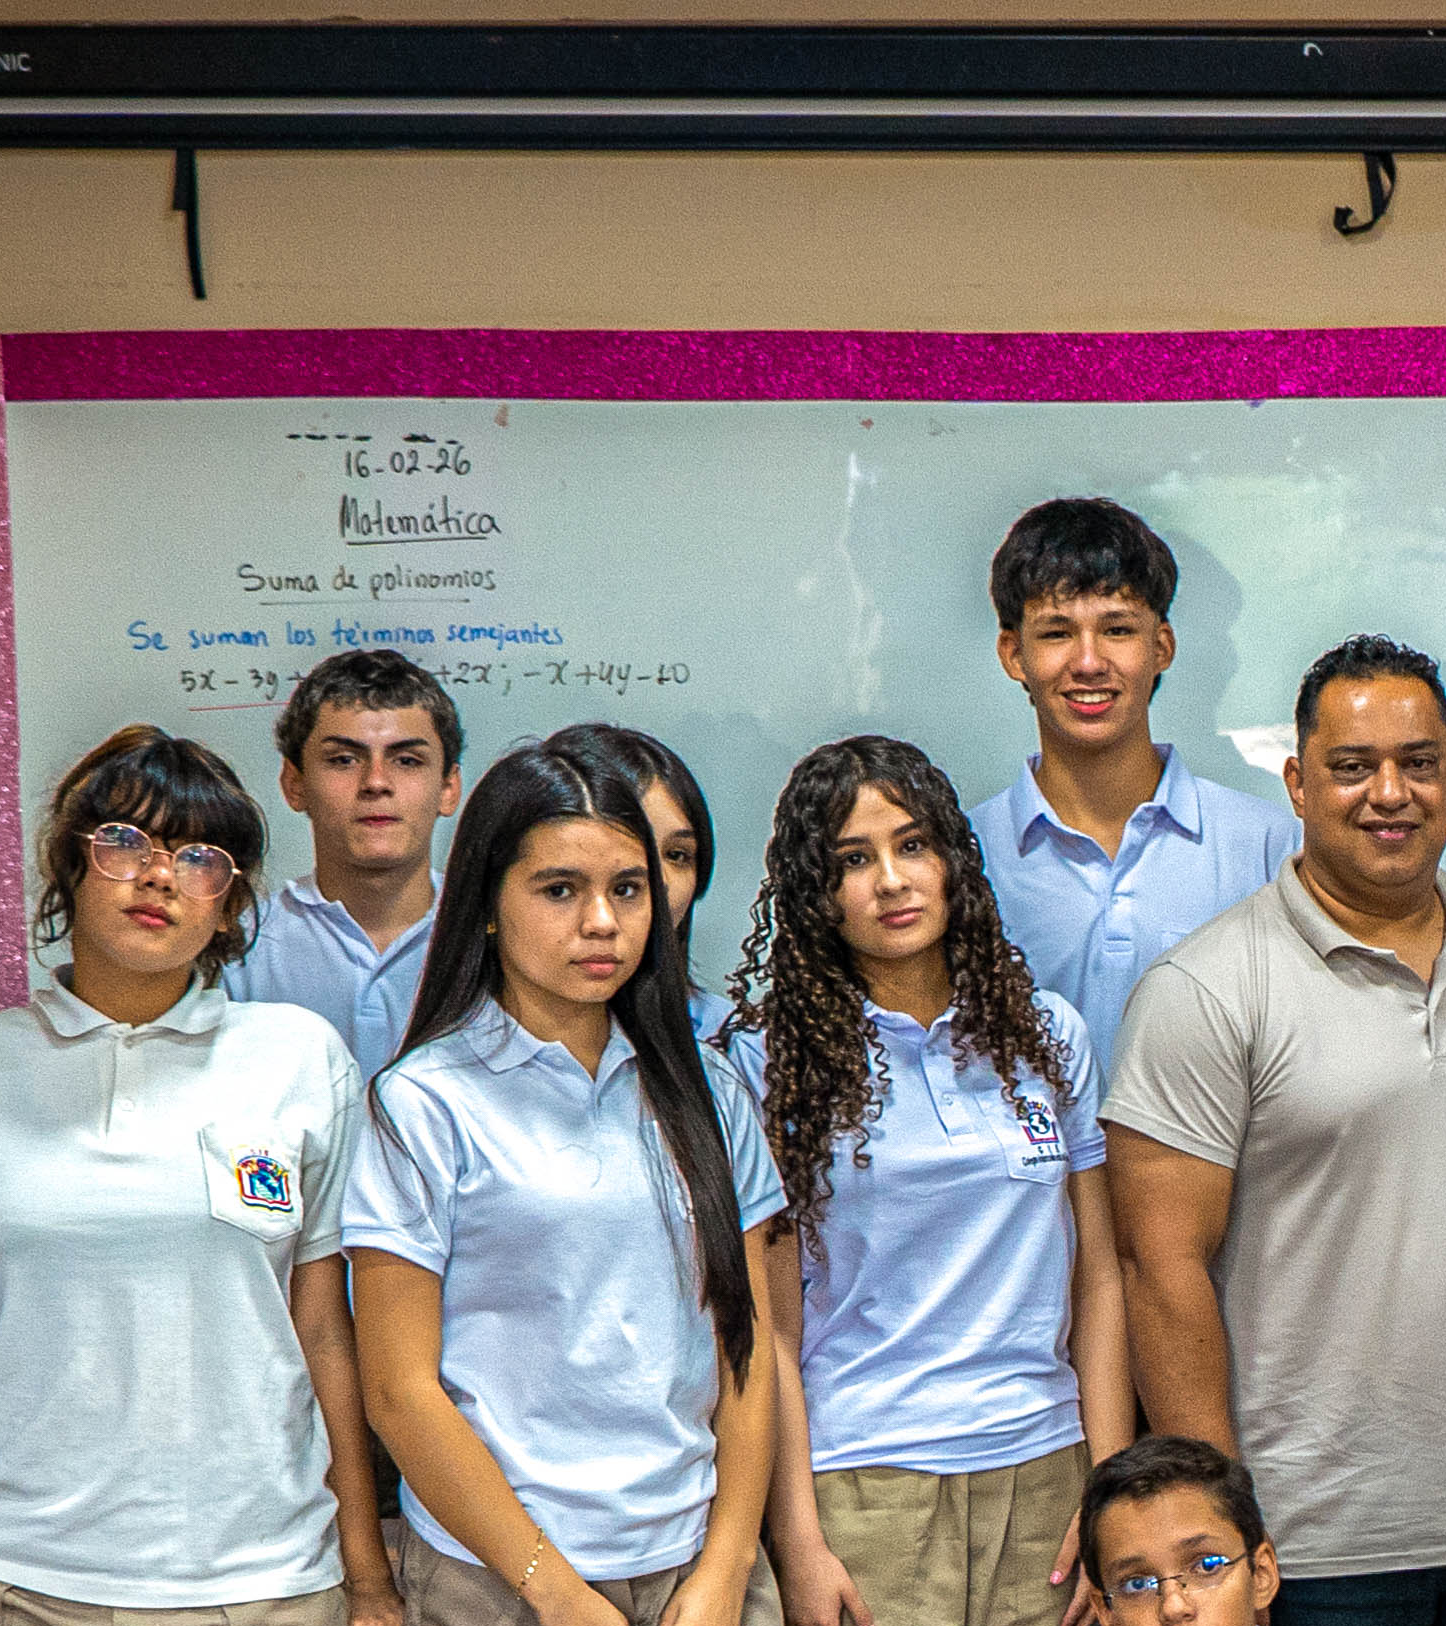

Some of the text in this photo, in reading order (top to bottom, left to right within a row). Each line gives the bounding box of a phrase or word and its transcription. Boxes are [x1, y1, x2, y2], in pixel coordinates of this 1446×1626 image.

[343, 446, 472, 479] 16-02-26
[338, 494, 502, 540] Matemática
[237, 563, 498, 602] Suma de polinomios
[127, 619, 170, 652] Se
[188, 627, 270, 651] suman
[285, 620, 317, 647] los
[447, 621, 564, 651] semejantes
